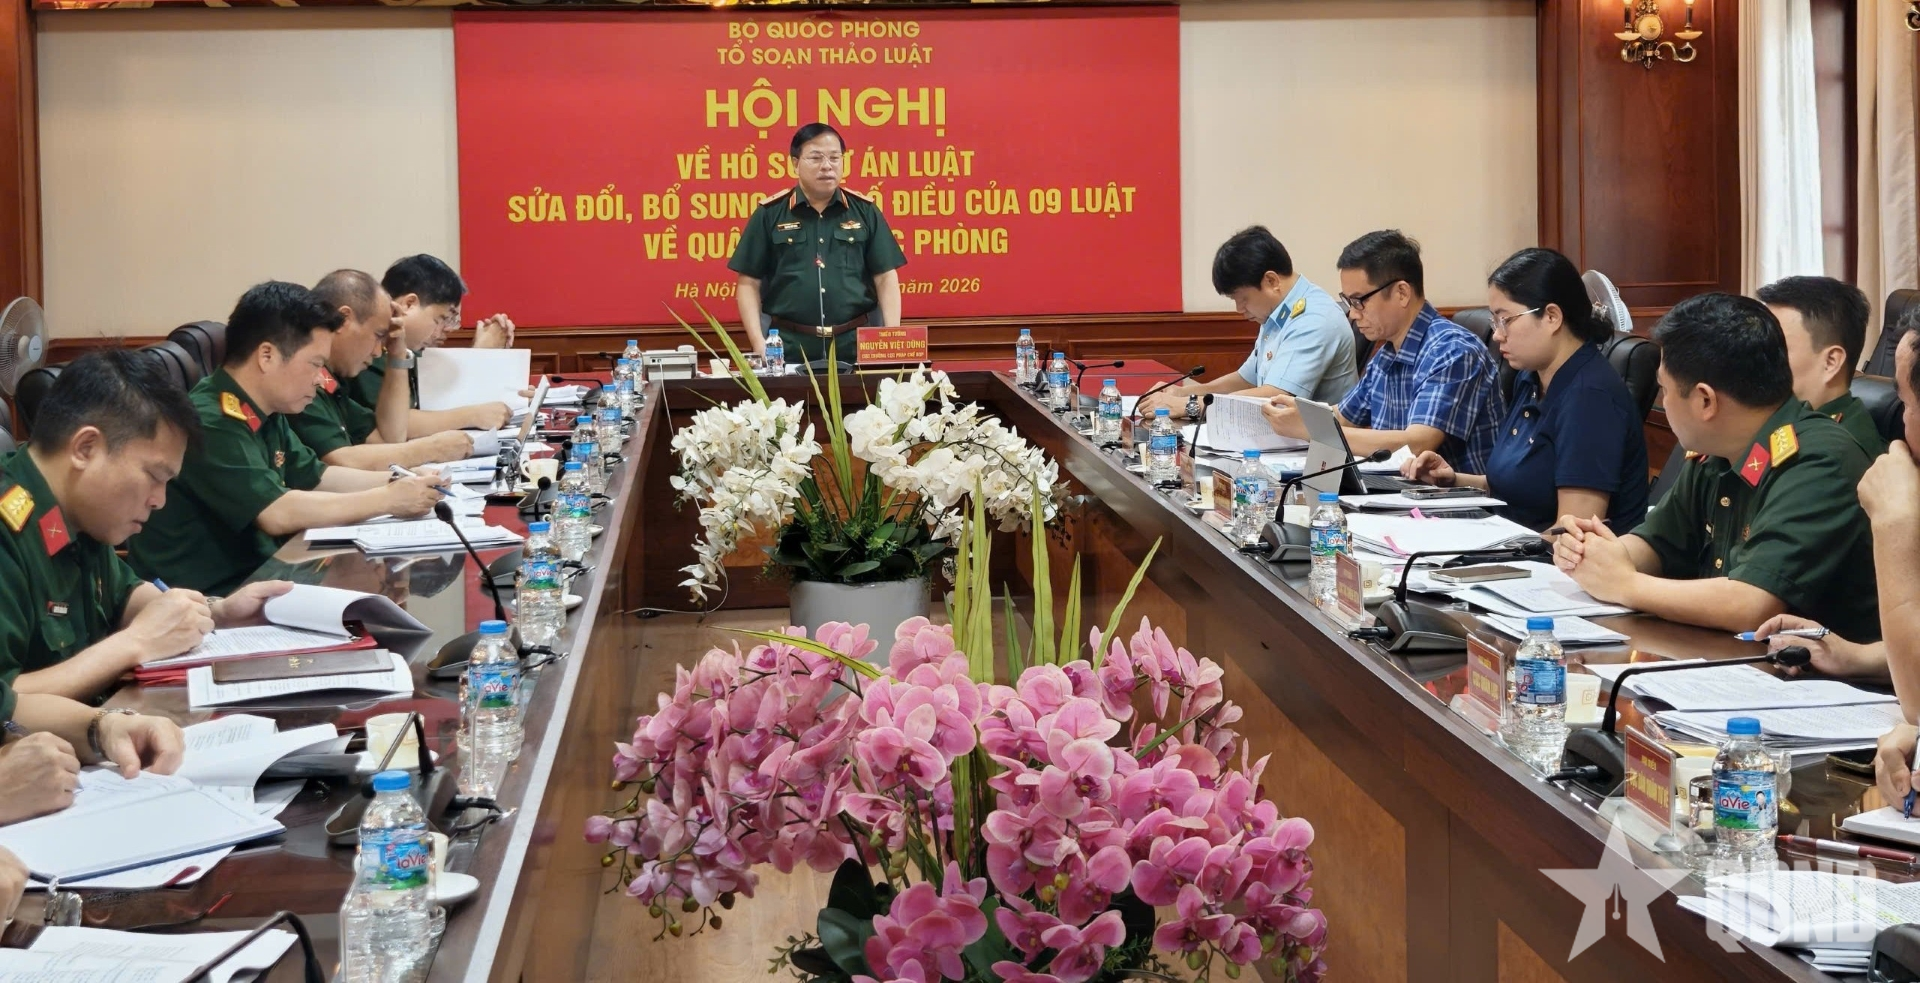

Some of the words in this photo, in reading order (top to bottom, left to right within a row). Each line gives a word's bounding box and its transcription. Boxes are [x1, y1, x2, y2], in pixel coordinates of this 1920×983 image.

[729, 18, 760, 43] BỘ
[766, 16, 834, 39] QUỐC
[841, 17, 921, 38] PHÒNG
[717, 40, 746, 65] TỔ
[752, 48, 812, 69] SOẠN
[818, 42, 877, 65] THẢO
[884, 43, 933, 68] LUẬT
[706, 77, 798, 139] HỘI
[818, 87, 946, 137] NGHỊ
[677, 144, 711, 180] VỀ
[721, 143, 758, 180] HỒ
[860, 146, 899, 178] ÁN
[908, 145, 975, 182] LUẬT
[508, 186, 567, 223] SỬA
[575, 184, 633, 224] ĐỔI,
[643, 182, 682, 220] BỔ
[892, 180, 956, 216] ĐIỀU
[965, 180, 1021, 215] CỦA
[1029, 188, 1061, 214] 09
[1070, 182, 1136, 218] LUẬT
[643, 225, 678, 260] VỀ
[914, 222, 1009, 255] PHÒNG
[675, 282, 699, 298] Hà
[939, 278, 980, 294] 2026
[1719, 796, 1750, 810] laVie
